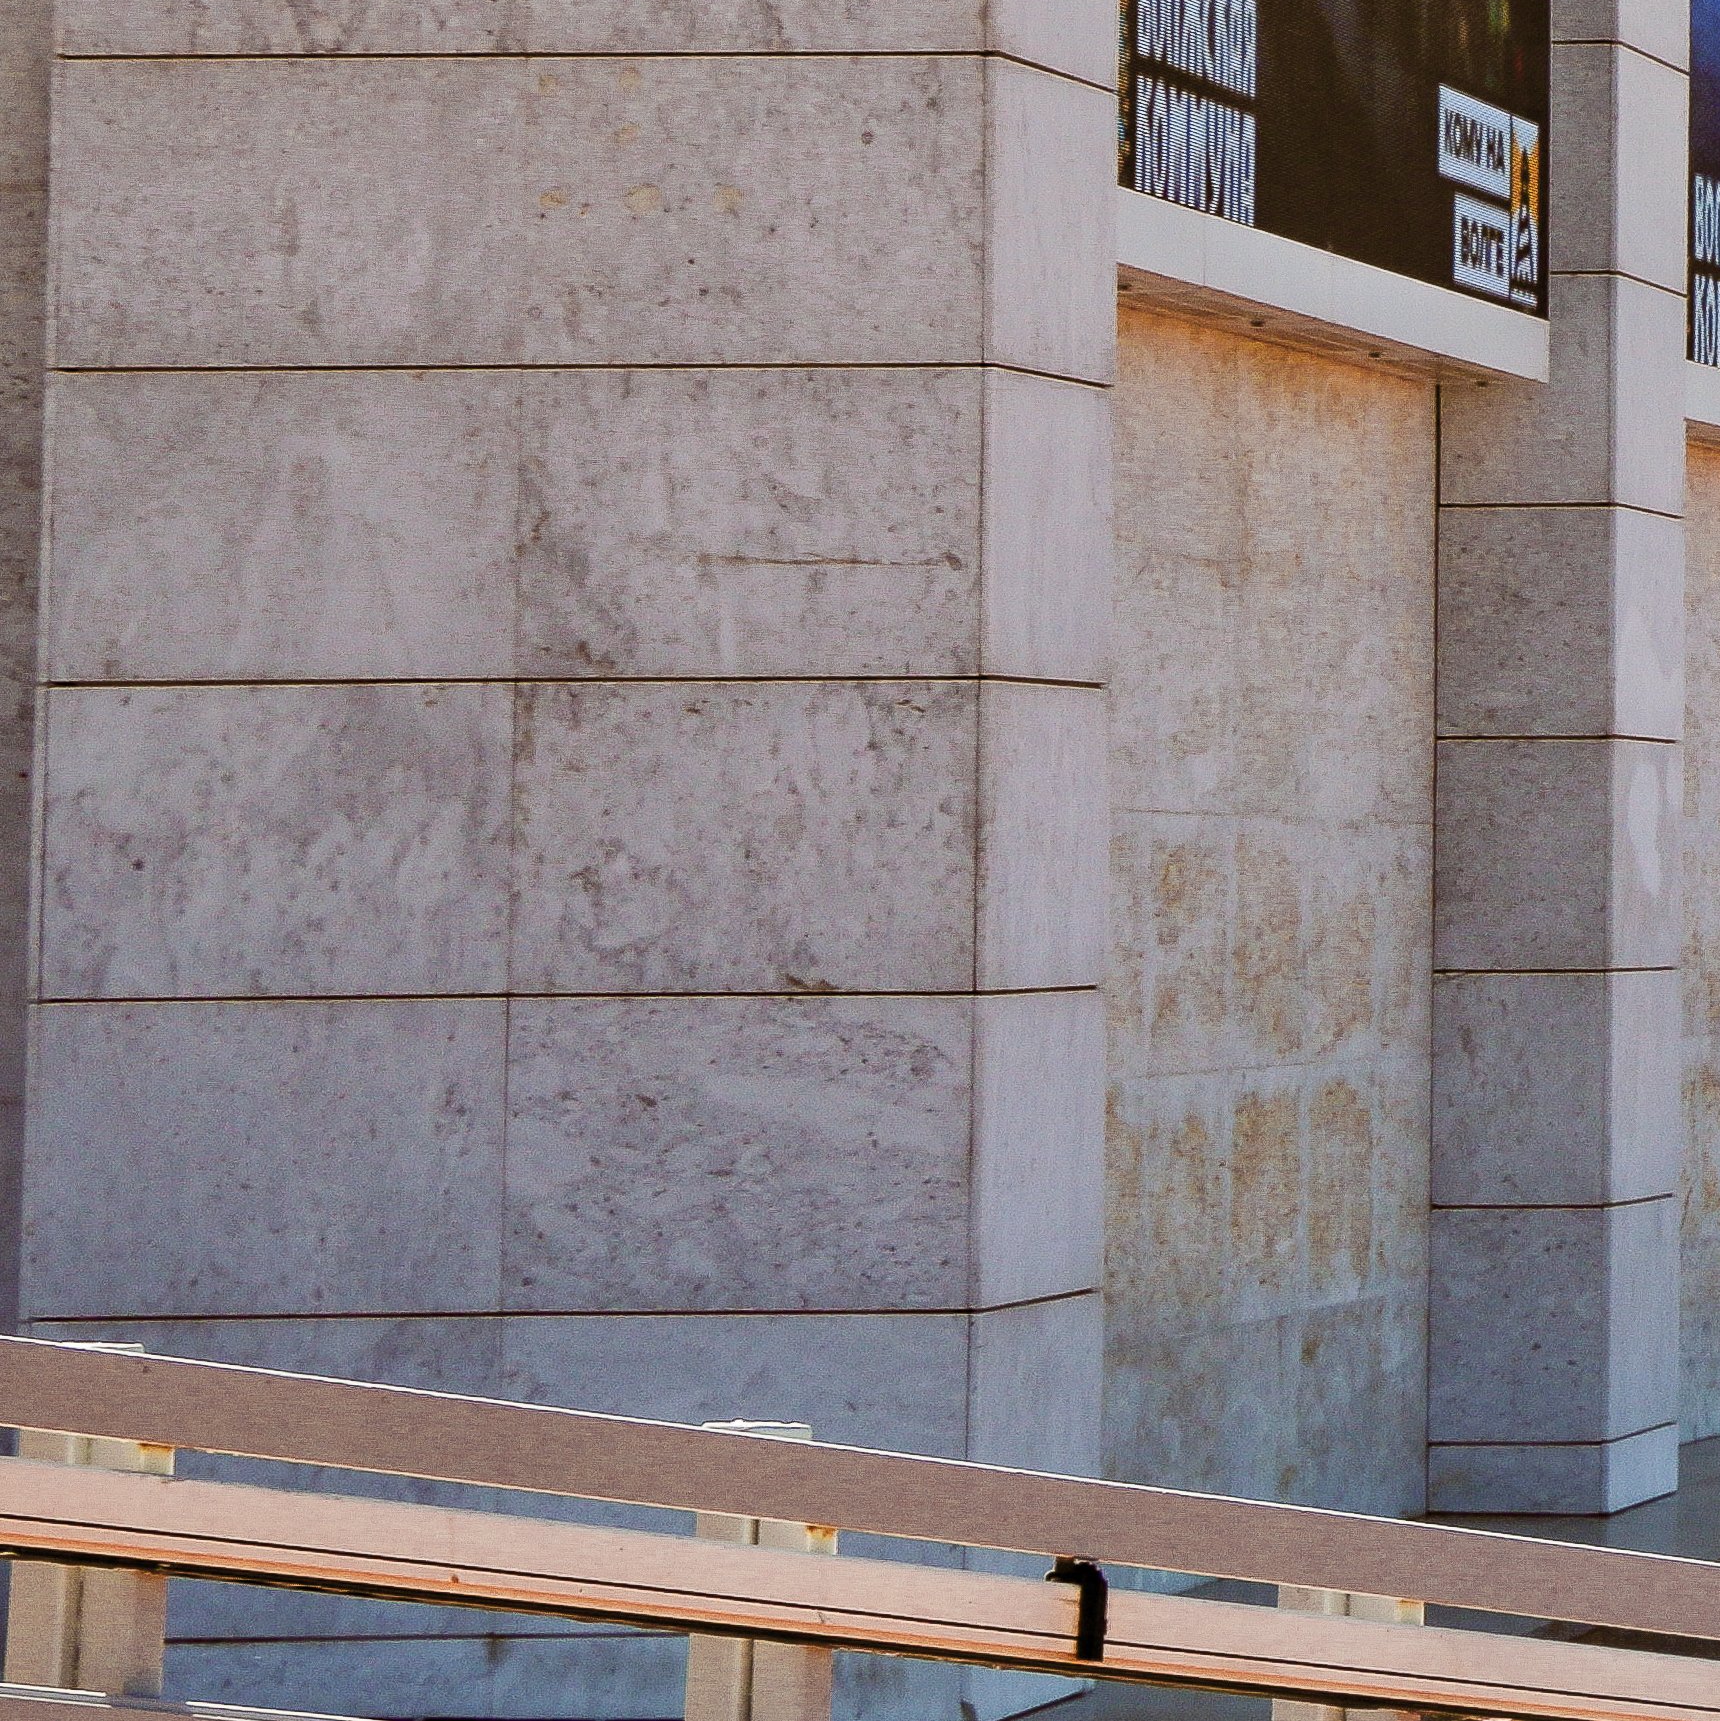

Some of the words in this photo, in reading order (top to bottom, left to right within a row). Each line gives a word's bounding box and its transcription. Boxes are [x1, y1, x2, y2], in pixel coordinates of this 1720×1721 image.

[1134, 74, 1256, 228] КОММУНА
[1444, 106, 1481, 167] КОМУ
[1486, 124, 1504, 175] НА
[1461, 214, 1503, 279] ВОЛГЕ
